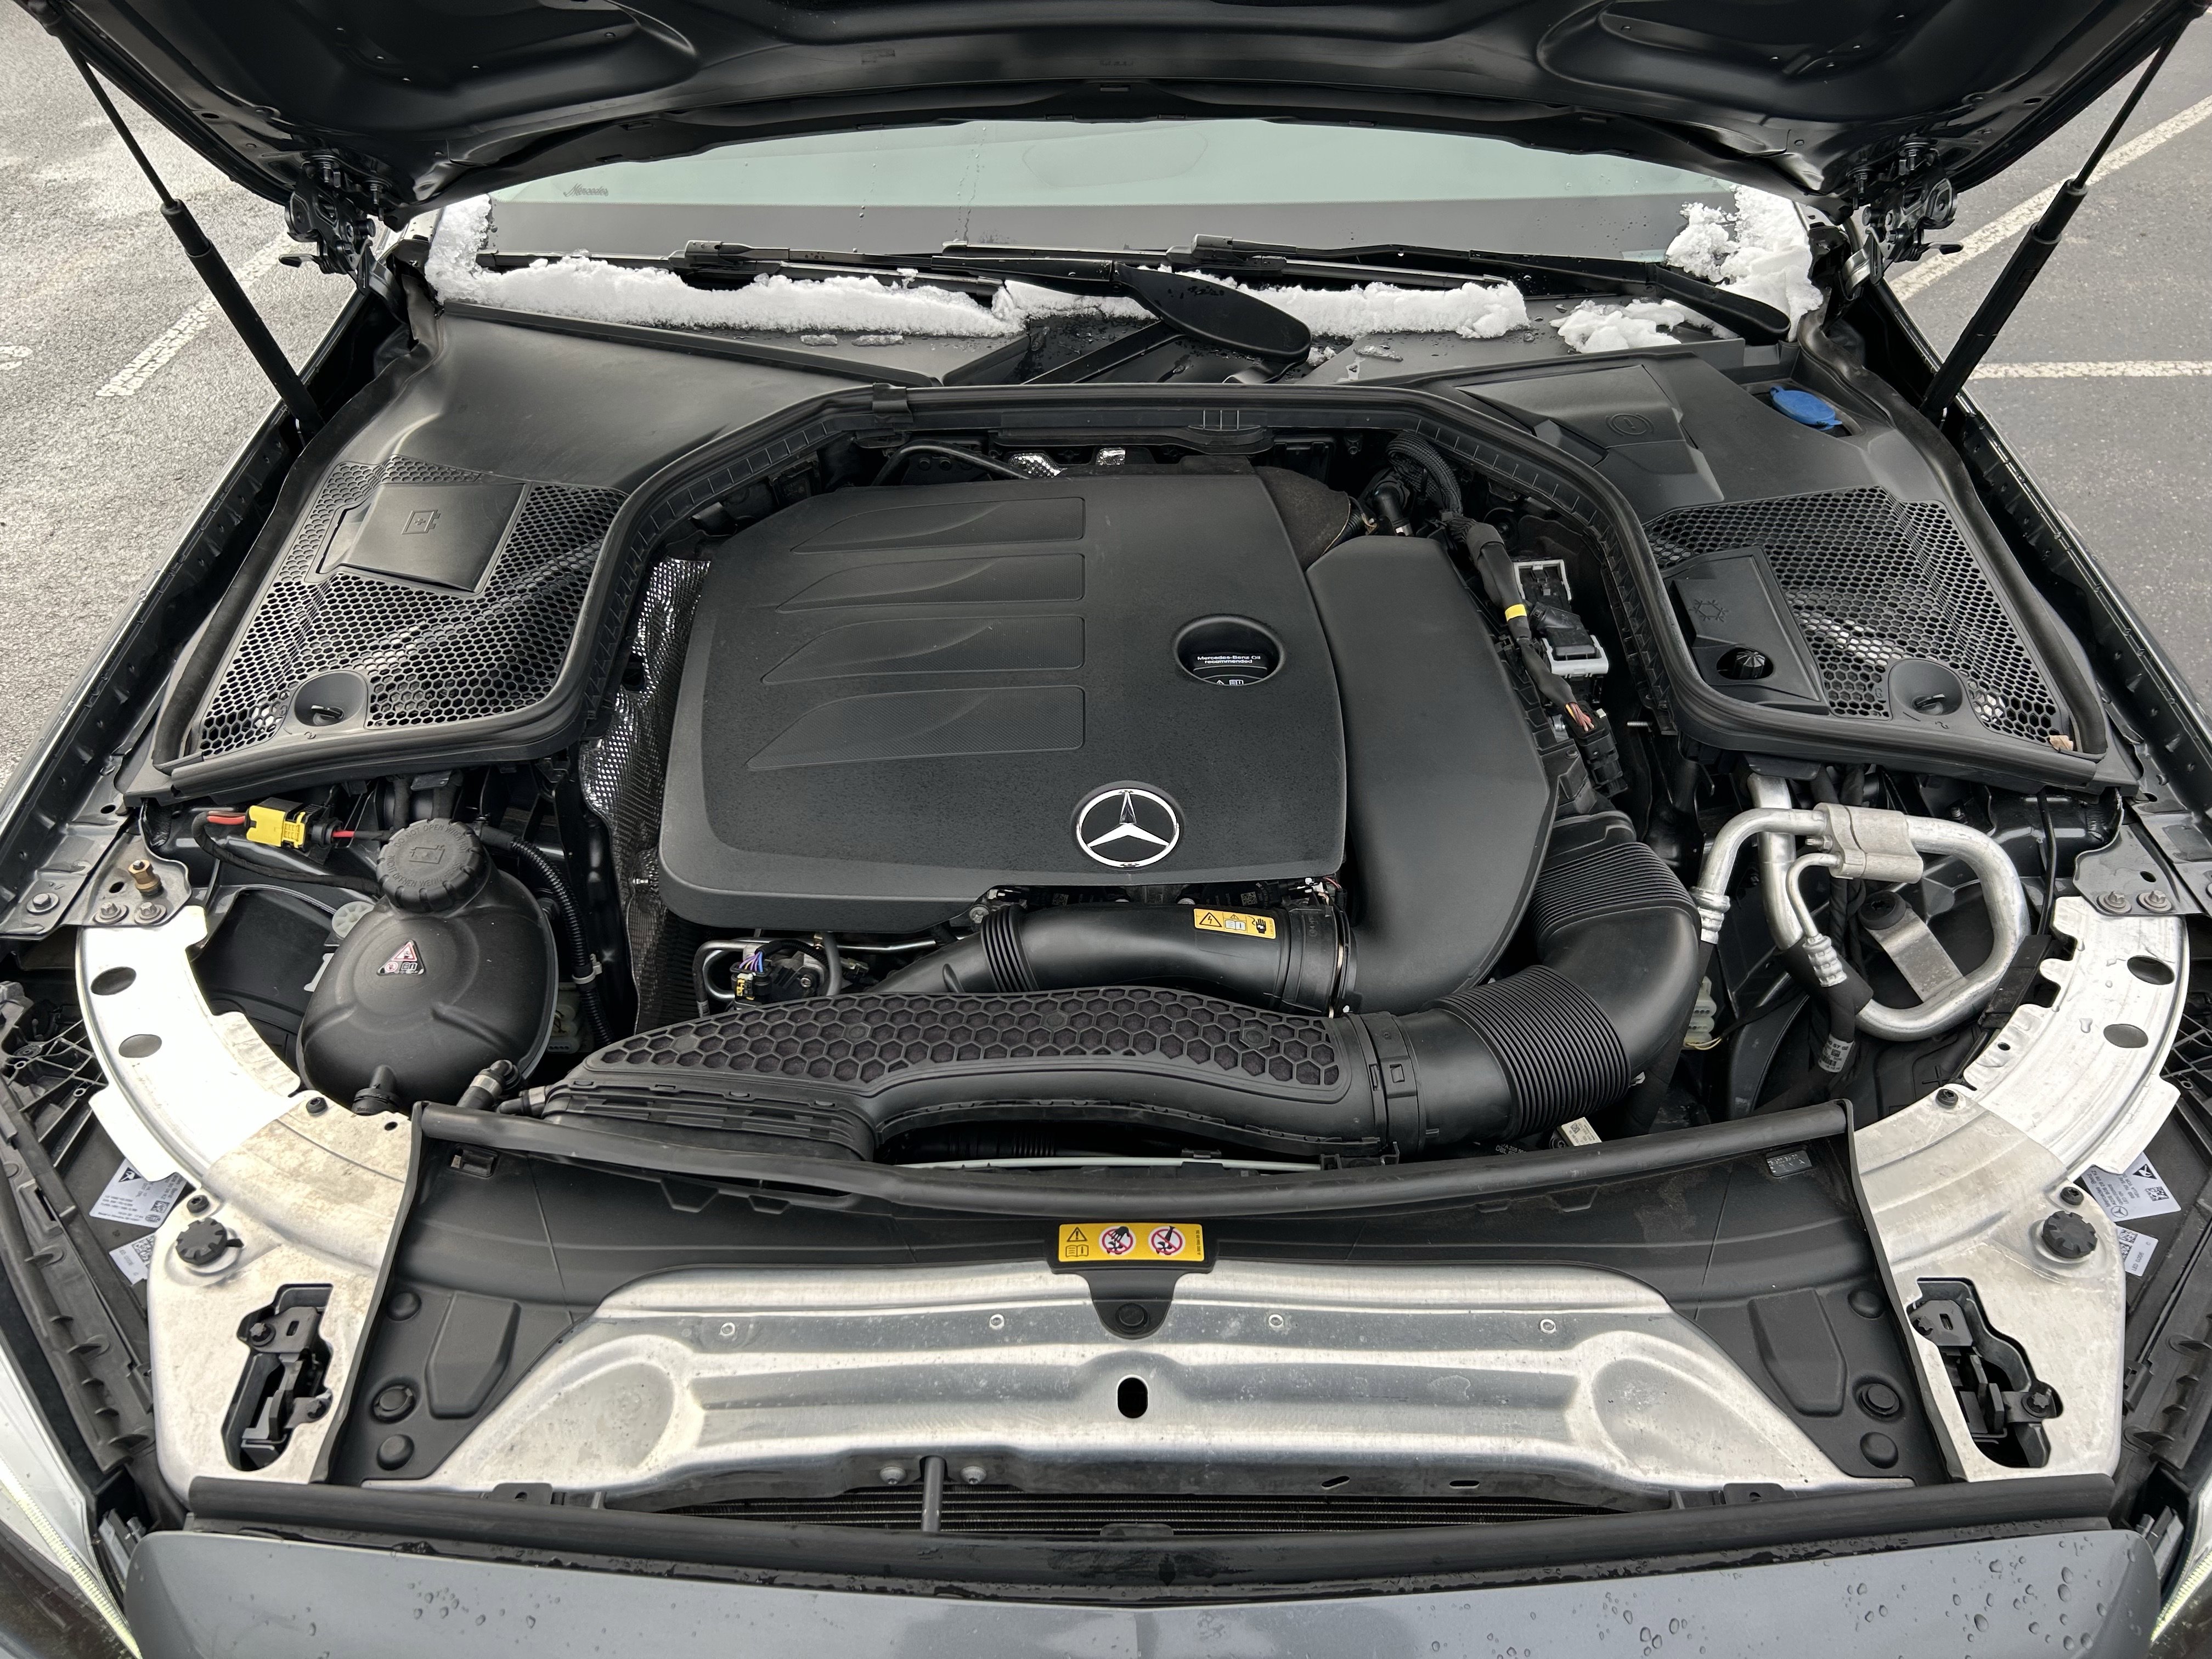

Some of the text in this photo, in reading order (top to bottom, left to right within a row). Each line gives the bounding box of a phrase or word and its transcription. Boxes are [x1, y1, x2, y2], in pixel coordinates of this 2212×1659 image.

[563, 183, 608, 197] Mercedes
[394, 838, 405, 848] DO
[405, 827, 420, 839] NOT
[445, 826, 464, 842] WHEN
